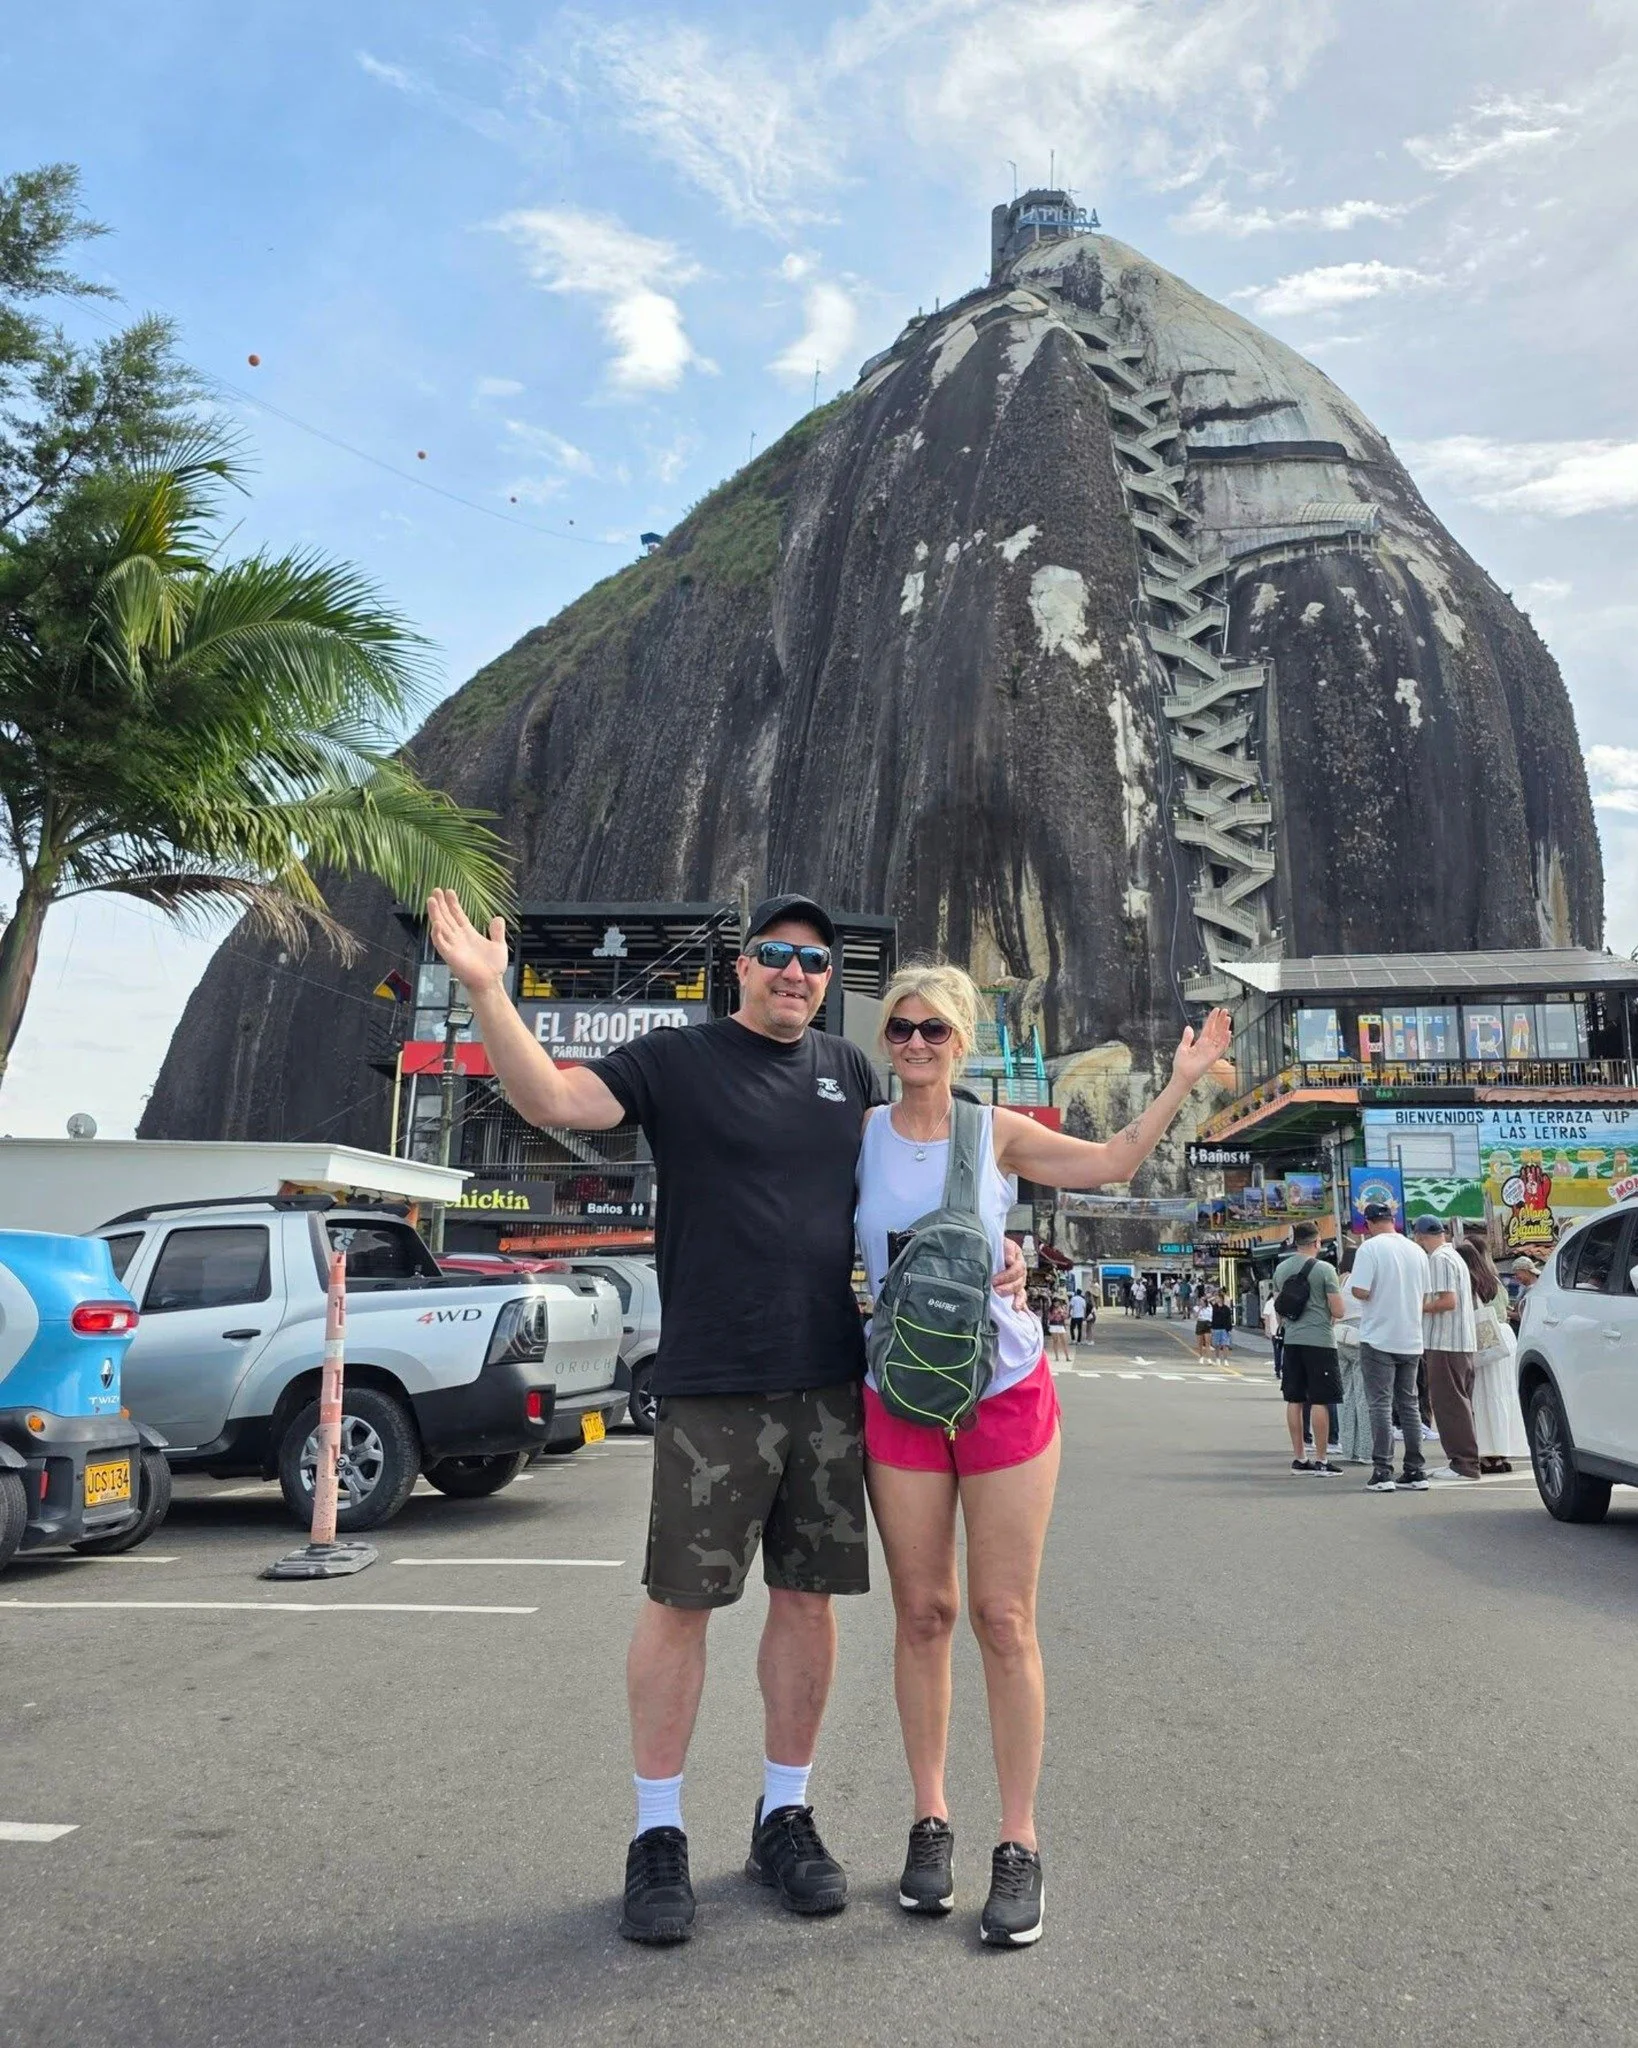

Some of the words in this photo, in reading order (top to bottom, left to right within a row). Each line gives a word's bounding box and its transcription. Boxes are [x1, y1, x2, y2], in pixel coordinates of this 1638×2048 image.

[536, 1012, 565, 1042] EL
[1395, 1110, 1484, 1125] BIENVENIDOS
[1492, 1111, 1500, 1123] A
[1506, 1110, 1522, 1124] LA
[1529, 1110, 1593, 1124] TERRAZA
[1602, 1110, 1630, 1123] VIP
[1500, 1126, 1526, 1139] LAS
[1534, 1126, 1587, 1139] LETRAS
[1199, 1148, 1237, 1163] Baños
[587, 1203, 623, 1214] Baños
[416, 1308, 483, 1325] 4WD
[555, 1357, 612, 1375] OROCH
[88, 1471, 108, 1494] JCS
[111, 1466, 129, 1491] 134
